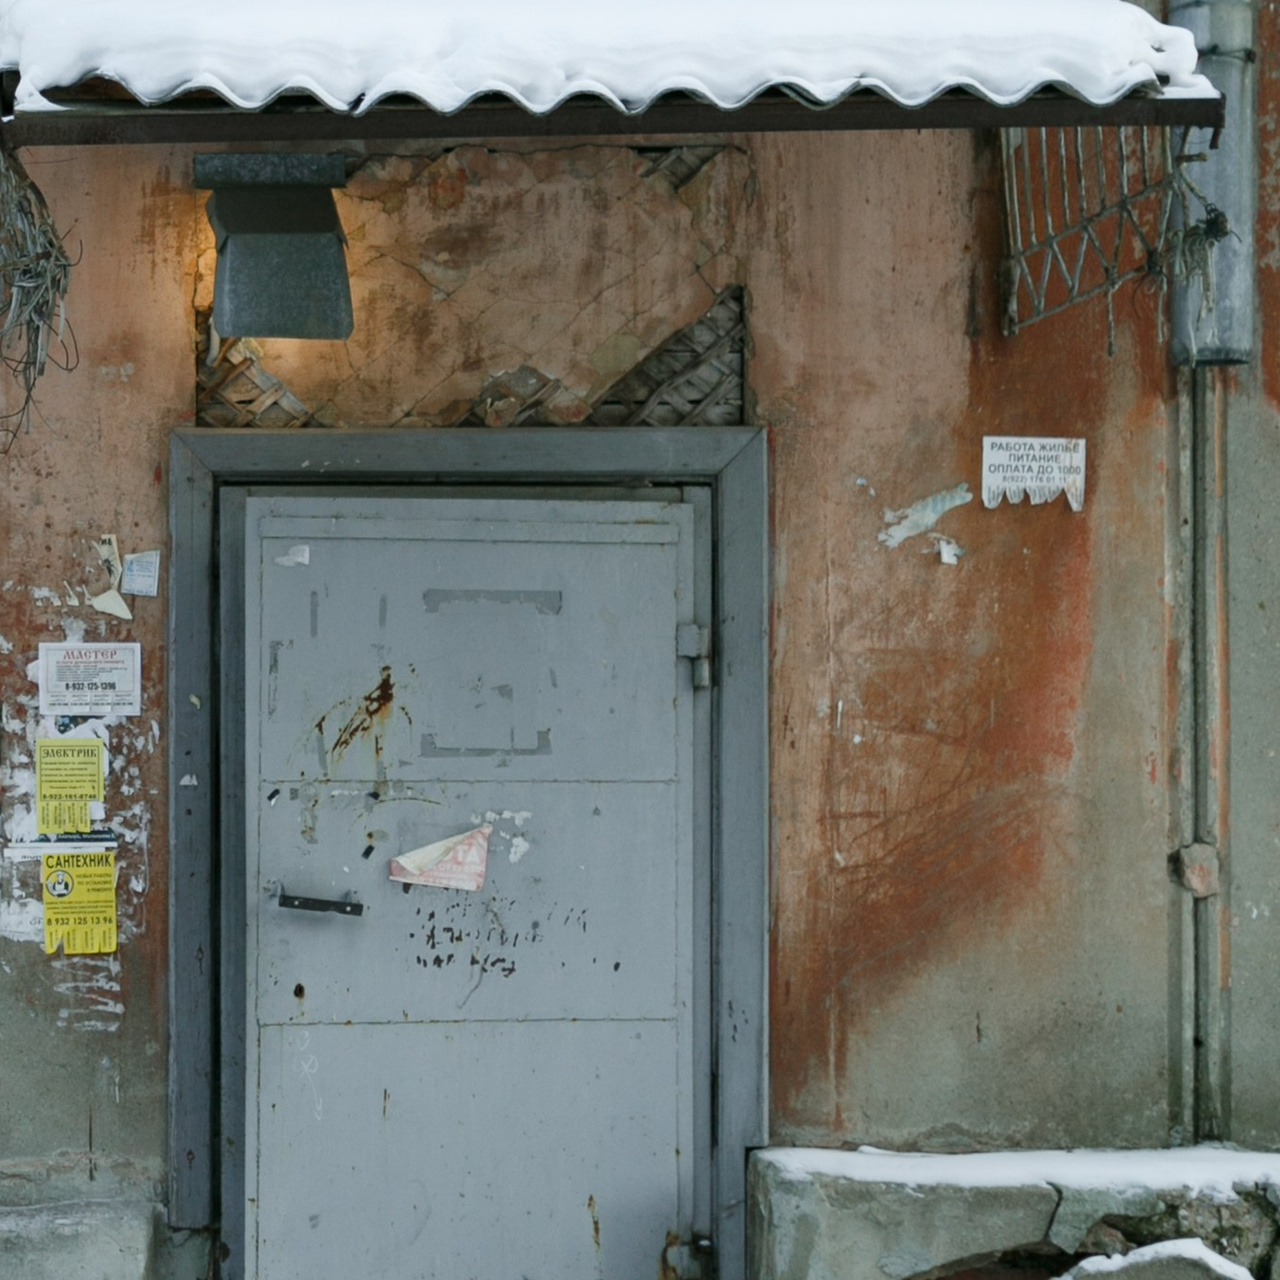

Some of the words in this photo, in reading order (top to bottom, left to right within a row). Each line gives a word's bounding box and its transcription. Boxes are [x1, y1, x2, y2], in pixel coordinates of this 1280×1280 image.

[990, 442, 1035, 452] РАБОТА
[1008, 453, 1061, 464] ПИТАНИЕ
[988, 464, 1034, 474] ОПЛАТА
[1037, 465, 1054, 476] ДО
[1057, 466, 1081, 475] 1000
[63, 649, 117, 660] МАСТЕР
[42, 748, 97, 759] ЭЛЕКТРИК
[46, 854, 111, 869] САНТЕХНИК
[47, 918, 52, 926] 8
[55, 917, 70, 925] 932
[73, 917, 88, 925] 125
[90, 917, 100, 925] 13
[103, 916, 113, 924] 96
